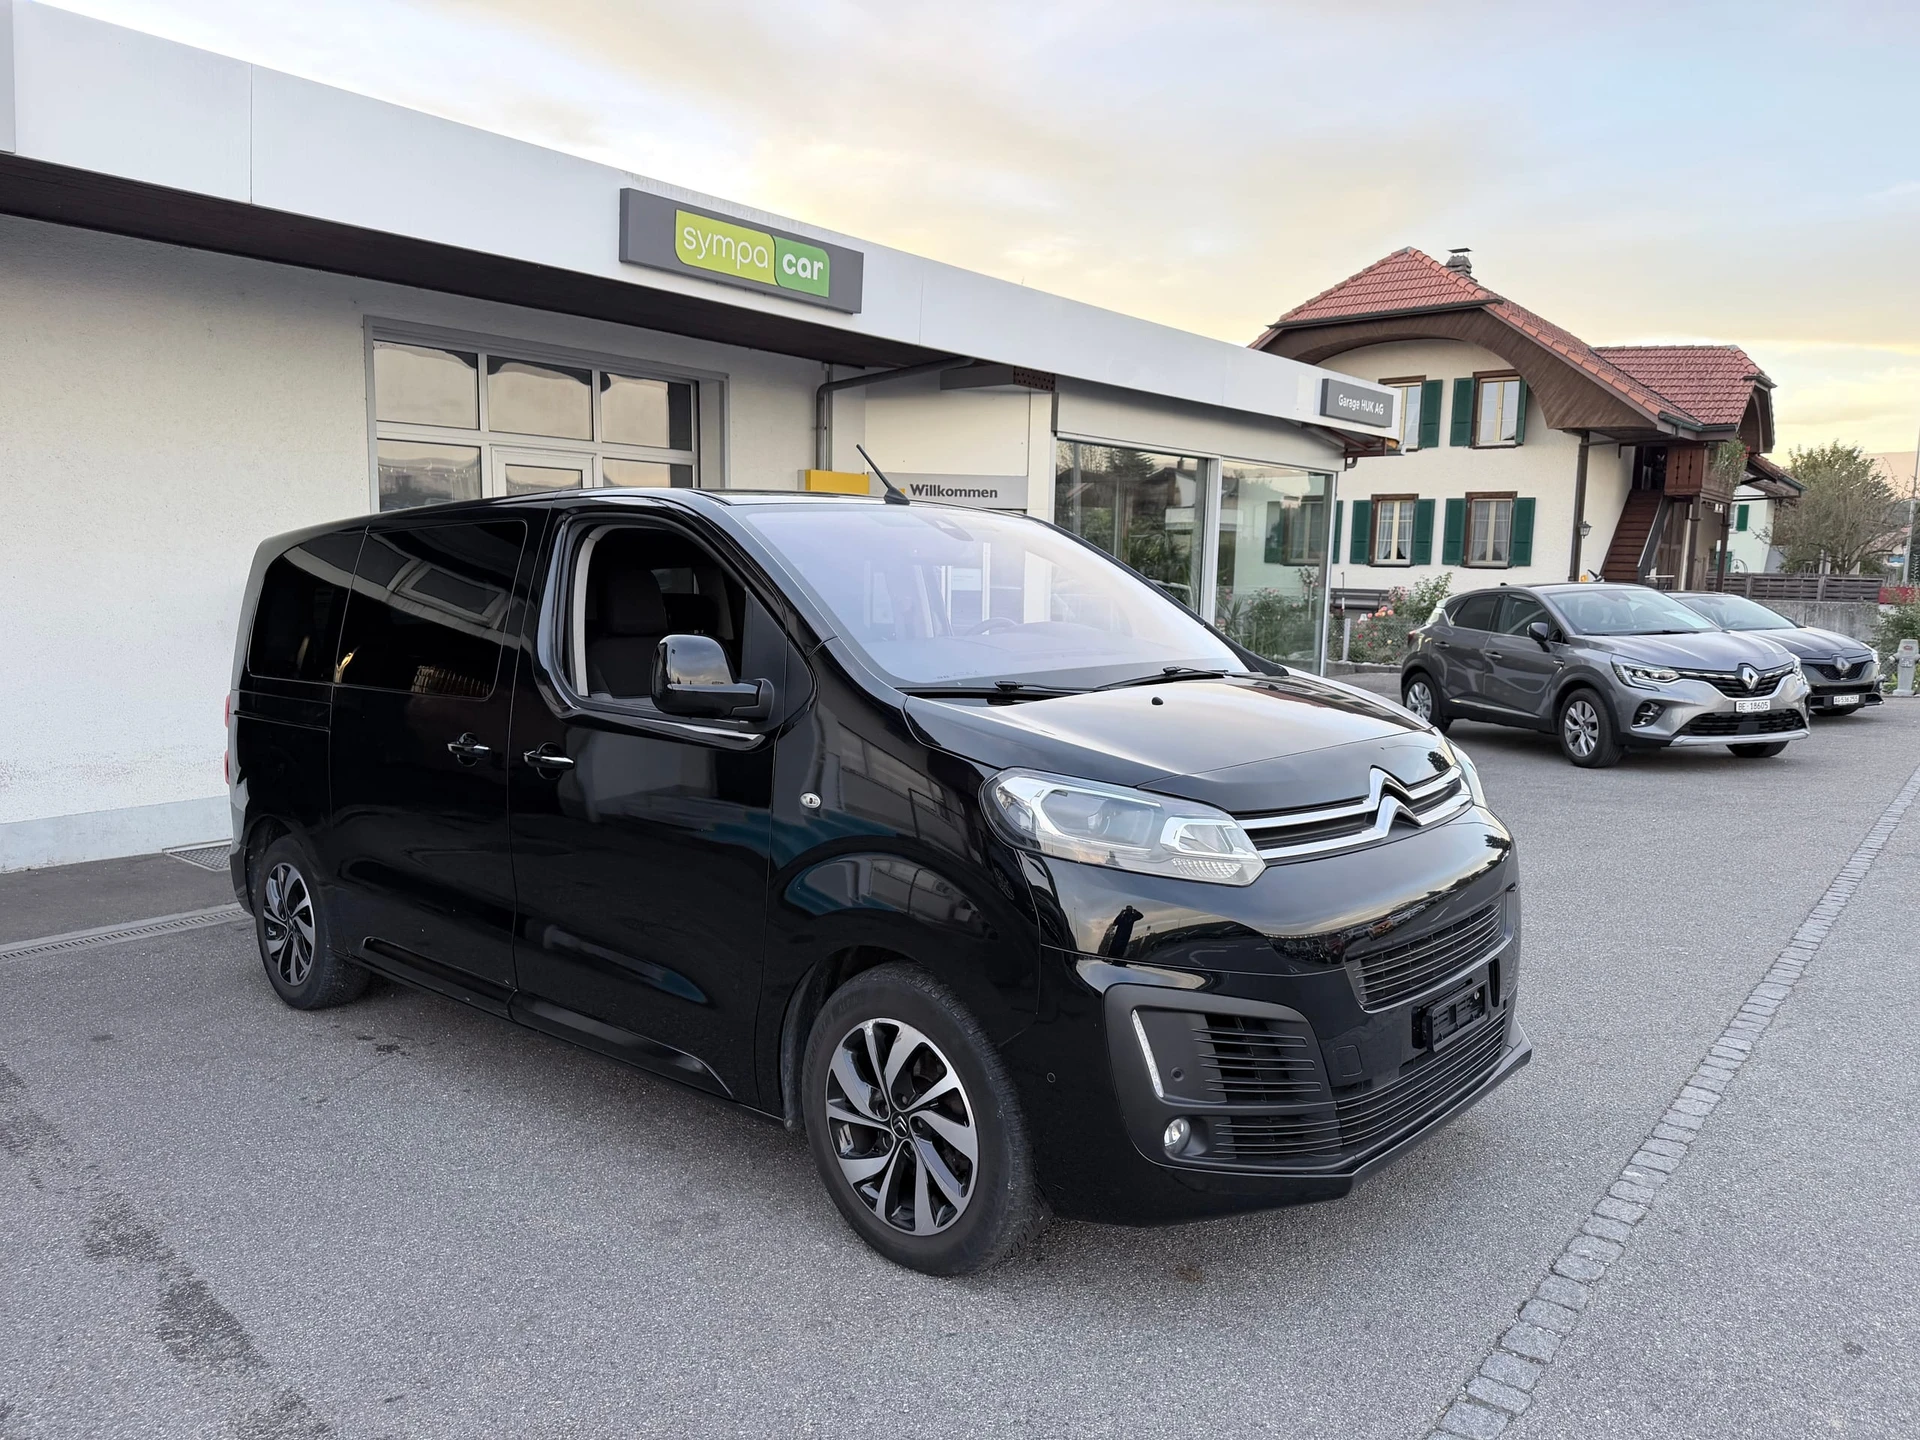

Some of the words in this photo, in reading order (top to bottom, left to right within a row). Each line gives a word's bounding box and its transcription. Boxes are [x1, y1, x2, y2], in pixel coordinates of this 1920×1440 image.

[683, 226, 769, 270] sympa
[782, 253, 823, 281] car
[1338, 394, 1360, 411] Garage
[1361, 399, 1374, 413] HUK
[1374, 402, 1384, 415] AG
[910, 483, 998, 498] Willkommen
